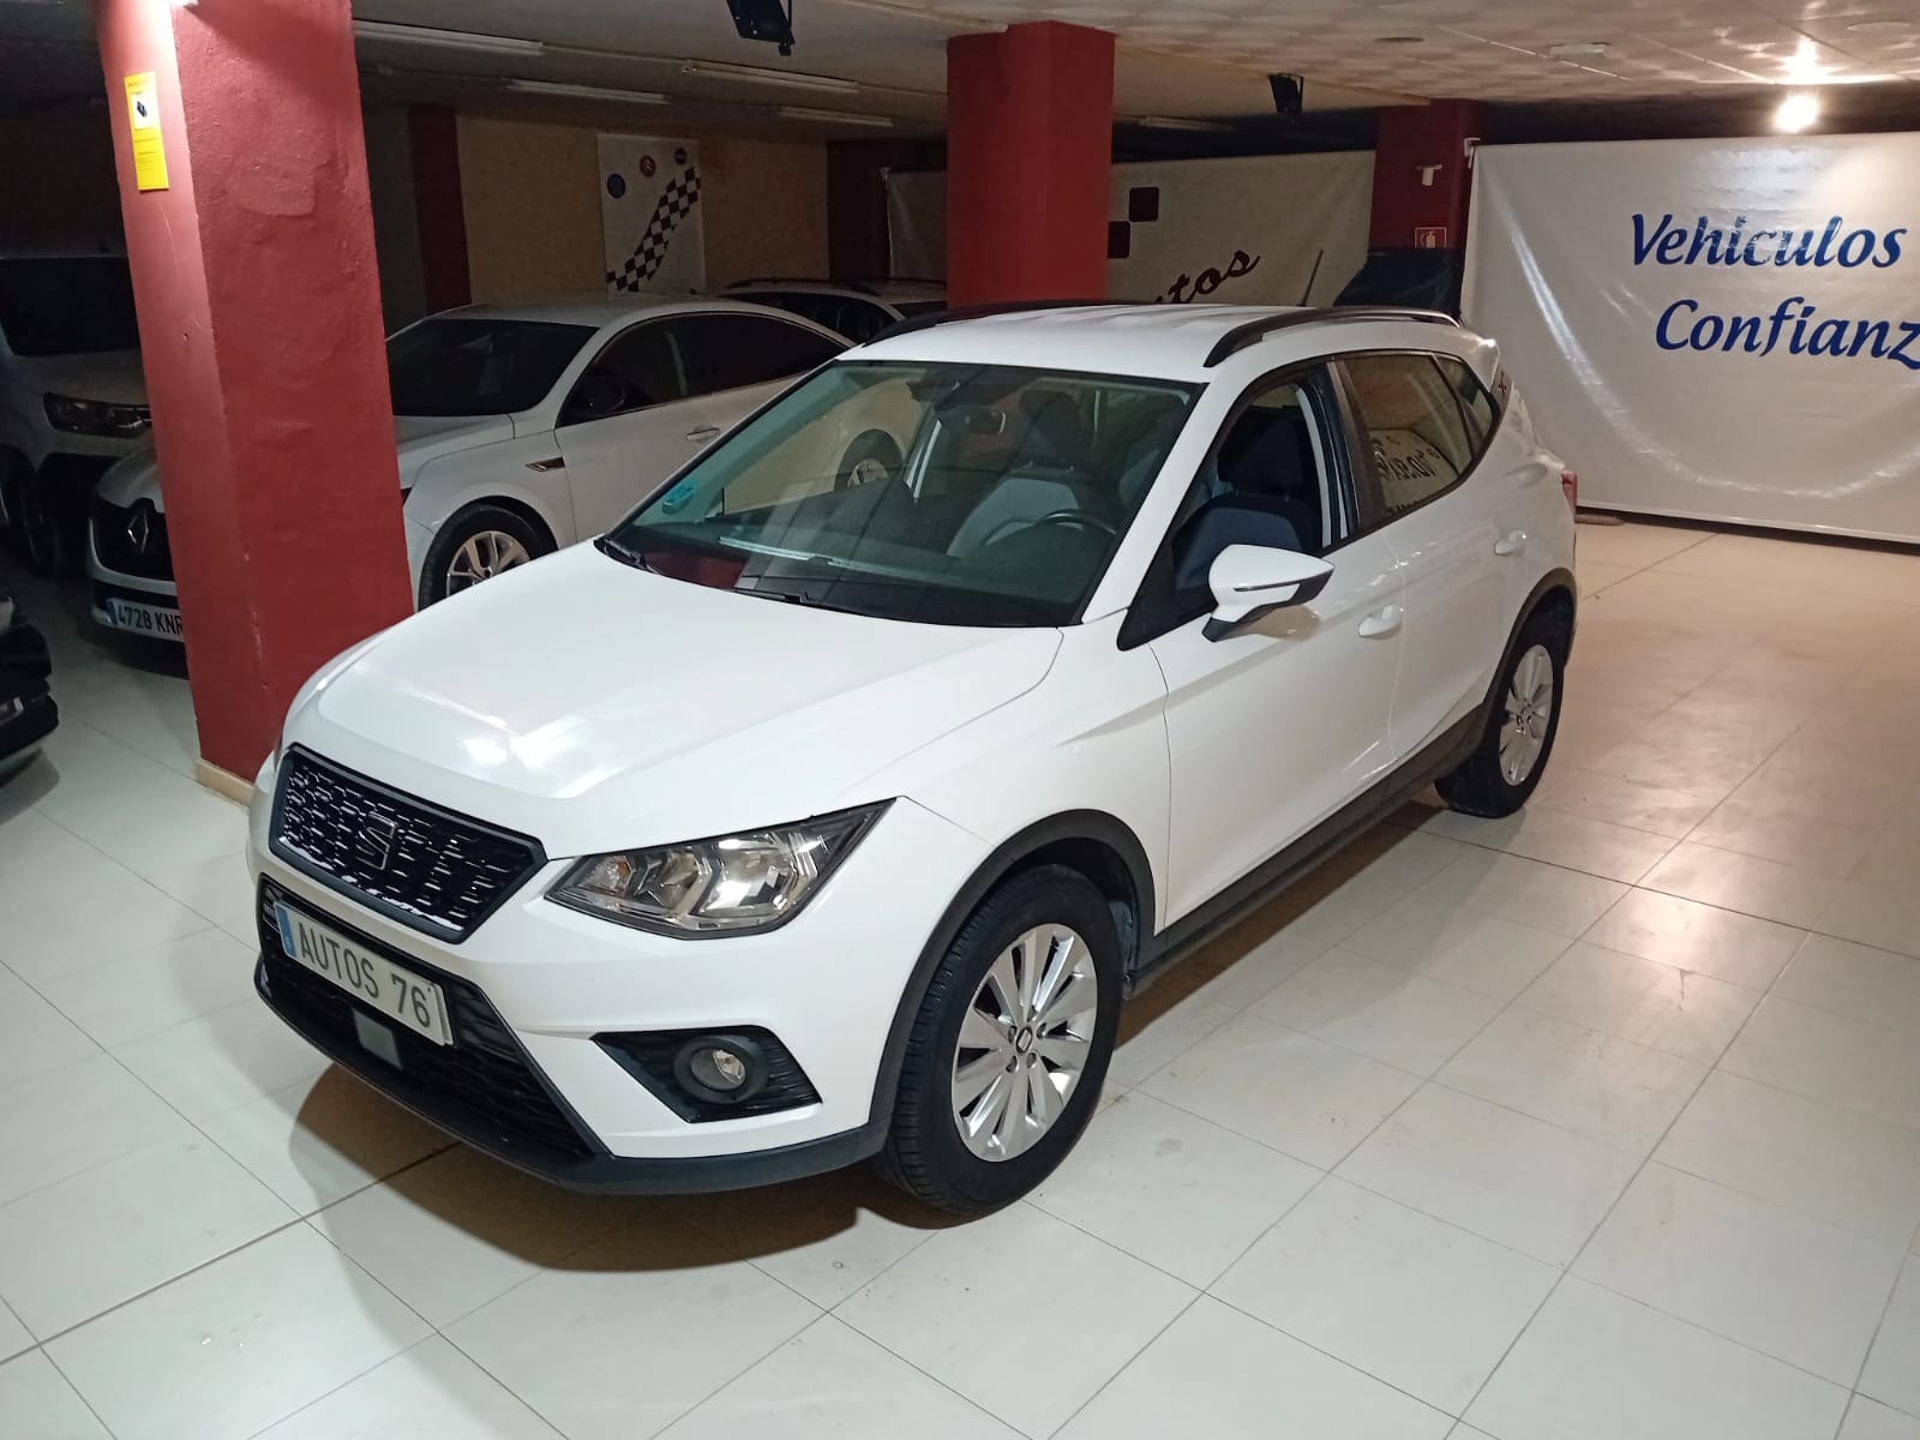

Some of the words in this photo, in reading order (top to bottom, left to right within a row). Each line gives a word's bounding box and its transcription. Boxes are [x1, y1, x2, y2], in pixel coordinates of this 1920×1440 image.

[1631, 213, 1908, 269] Vehiculos
[1155, 250, 1261, 304] tos
[118, 604, 153, 630] 4728
[298, 922, 380, 1000] AUTOS
[390, 972, 431, 1028] 76
